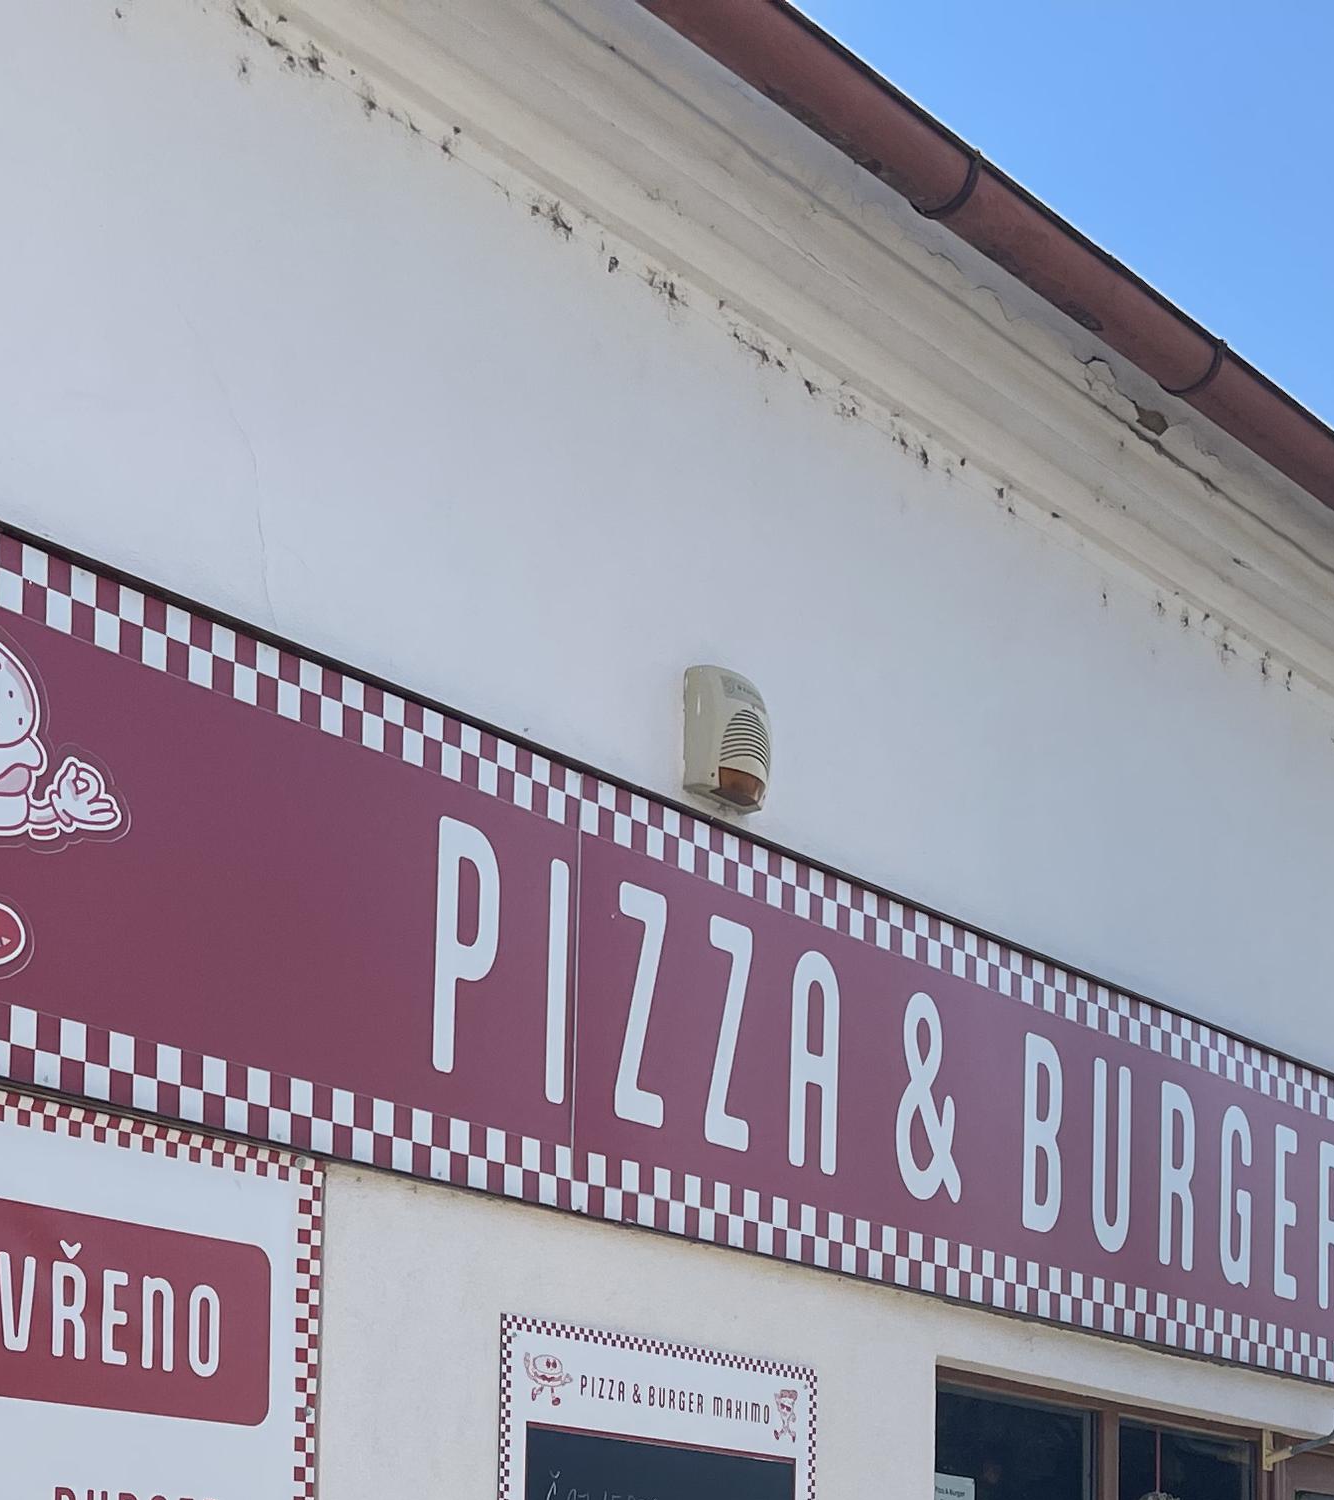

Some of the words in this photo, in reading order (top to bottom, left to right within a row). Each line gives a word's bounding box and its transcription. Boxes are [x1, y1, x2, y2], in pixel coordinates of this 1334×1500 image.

[431, 814, 841, 1176] PIZZA
[895, 991, 962, 1203] &
[580, 1374, 625, 1402] PIZZA
[632, 1383, 642, 1404] &
[648, 1385, 704, 1414] BURGER
[713, 1396, 770, 1424] MAXIMO
